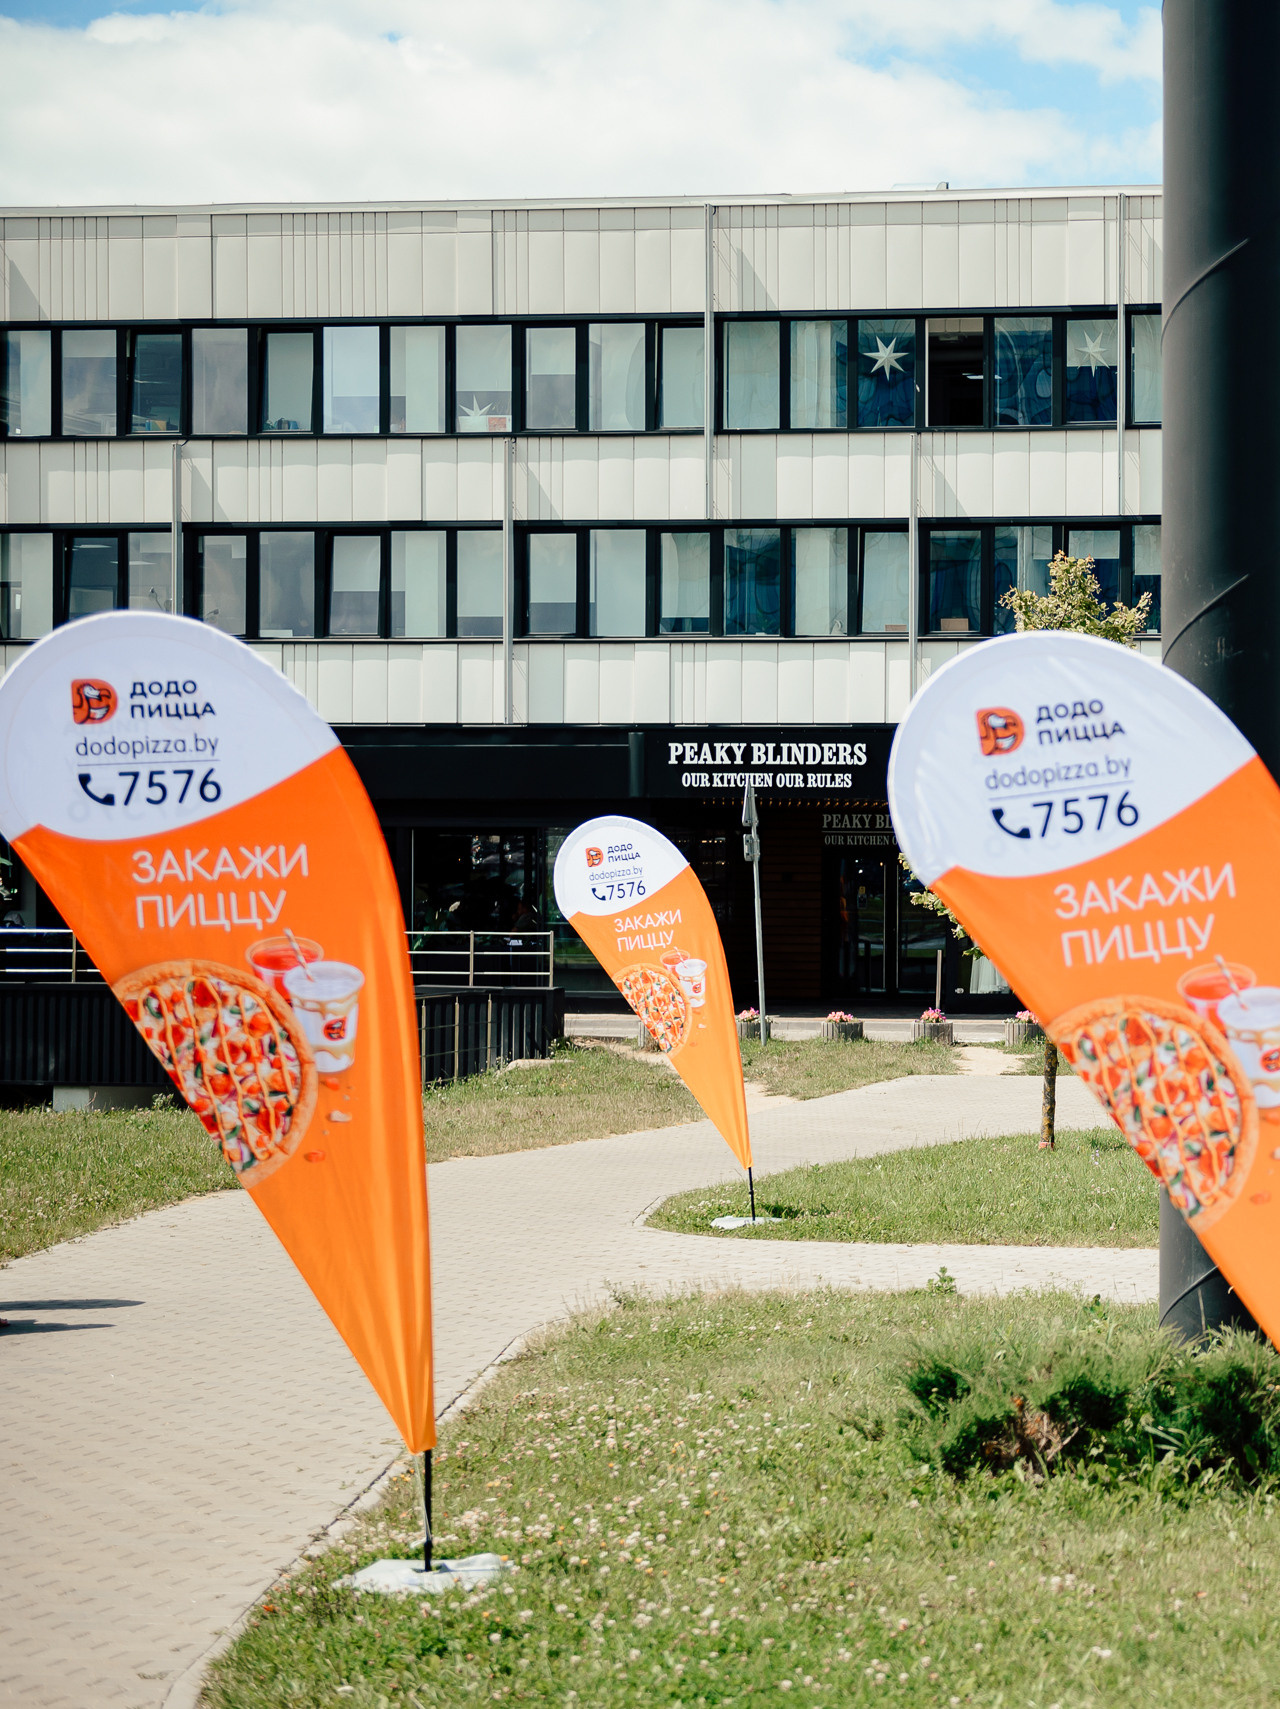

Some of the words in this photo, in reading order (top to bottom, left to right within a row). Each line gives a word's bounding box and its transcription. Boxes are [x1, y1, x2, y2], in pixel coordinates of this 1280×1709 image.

[130, 680, 197, 698] ДОДО
[130, 701, 216, 720] ПИЦЦА
[1036, 699, 1104, 724] ДОДО
[1038, 720, 1125, 746] ПИЦЦА
[76, 734, 219, 759] dodopizza.by
[668, 743, 747, 764] PEAKY
[751, 743, 867, 766] BLINDERS
[682, 773, 710, 787] OUR
[712, 772, 773, 788] KITCHEN
[776, 773, 804, 787] OUR
[806, 773, 852, 788] RULES
[985, 754, 1132, 790] dodopizza.by
[118, 768, 222, 806] 7576
[822, 814, 872, 828] PEAKY
[1032, 790, 1139, 838] 7576
[607, 843, 633, 854] ДОДО
[824, 835, 844, 846] OUR
[847, 835, 890, 846] KITCHEN
[131, 843, 309, 884] ЗАКАЖИ
[608, 852, 640, 863] ПИЦЦА
[589, 866, 643, 881] dodopizza.by
[606, 880, 646, 901] 7576
[1053, 862, 1236, 920] ЗАКАЖИ
[136, 890, 287, 932] ПИЦЦУ
[614, 909, 682, 933] ЗАКАЖИ
[617, 930, 674, 952] ПИЦЦУ
[1060, 914, 1215, 967] ПИЦЦУ
